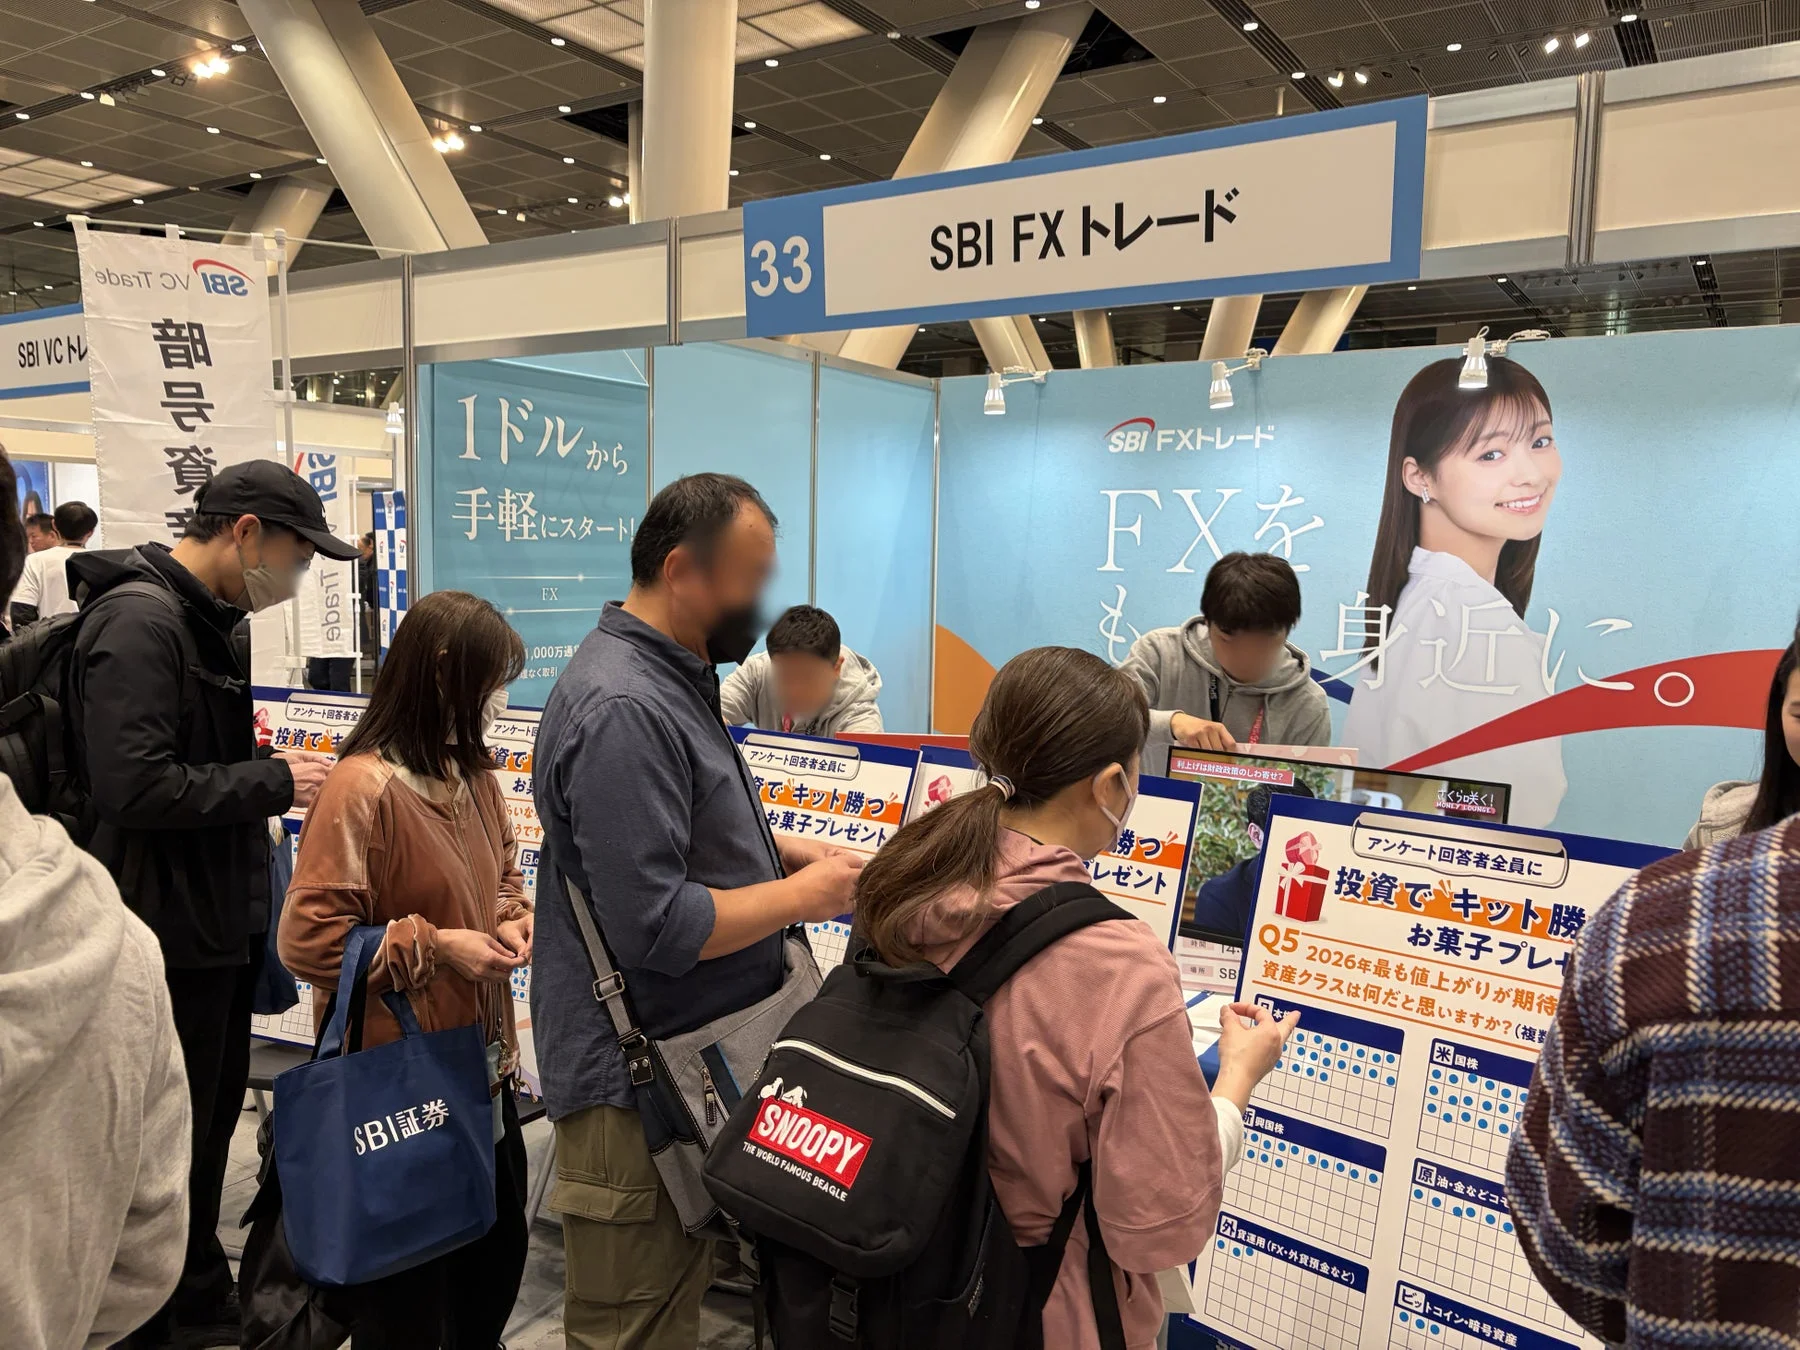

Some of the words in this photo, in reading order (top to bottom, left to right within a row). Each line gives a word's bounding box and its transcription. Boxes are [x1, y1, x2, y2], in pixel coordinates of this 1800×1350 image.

[929, 218, 994, 271] SBI
[1013, 209, 1066, 262] FX
[1081, 187, 1240, 257] トレード
[750, 235, 812, 298] 33
[18, 340, 40, 368] SBI
[44, 337, 63, 365] VC
[457, 394, 628, 475] 1ドルから
[1108, 430, 1149, 453] SBI
[1156, 425, 1274, 452] FXトレード
[452, 486, 635, 542] 手軽にスタート!
[1097, 484, 1327, 574] FXを
[542, 587, 559, 601] FX
[525, 645, 580, 661] 1,000万通
[750, 750, 847, 773] アンケート回答者全員に
[507, 804, 539, 821] らいな
[767, 809, 887, 847] お菓子プレゼント
[1368, 836, 1543, 876] アンケート回答者全員に
[1258, 924, 1300, 956] Q5
[1306, 945, 1559, 1017] 2026年最も値上がりが期待
[1435, 1045, 1479, 1071] 米国株
[354, 1099, 450, 1156] SBI証券
[757, 1104, 864, 1175] SNOOPY
[742, 1141, 756, 1155] THE
[757, 1148, 781, 1167] WORLD
[780, 1159, 812, 1183] FAMOUS
[812, 1176, 849, 1202] BEAGLE
